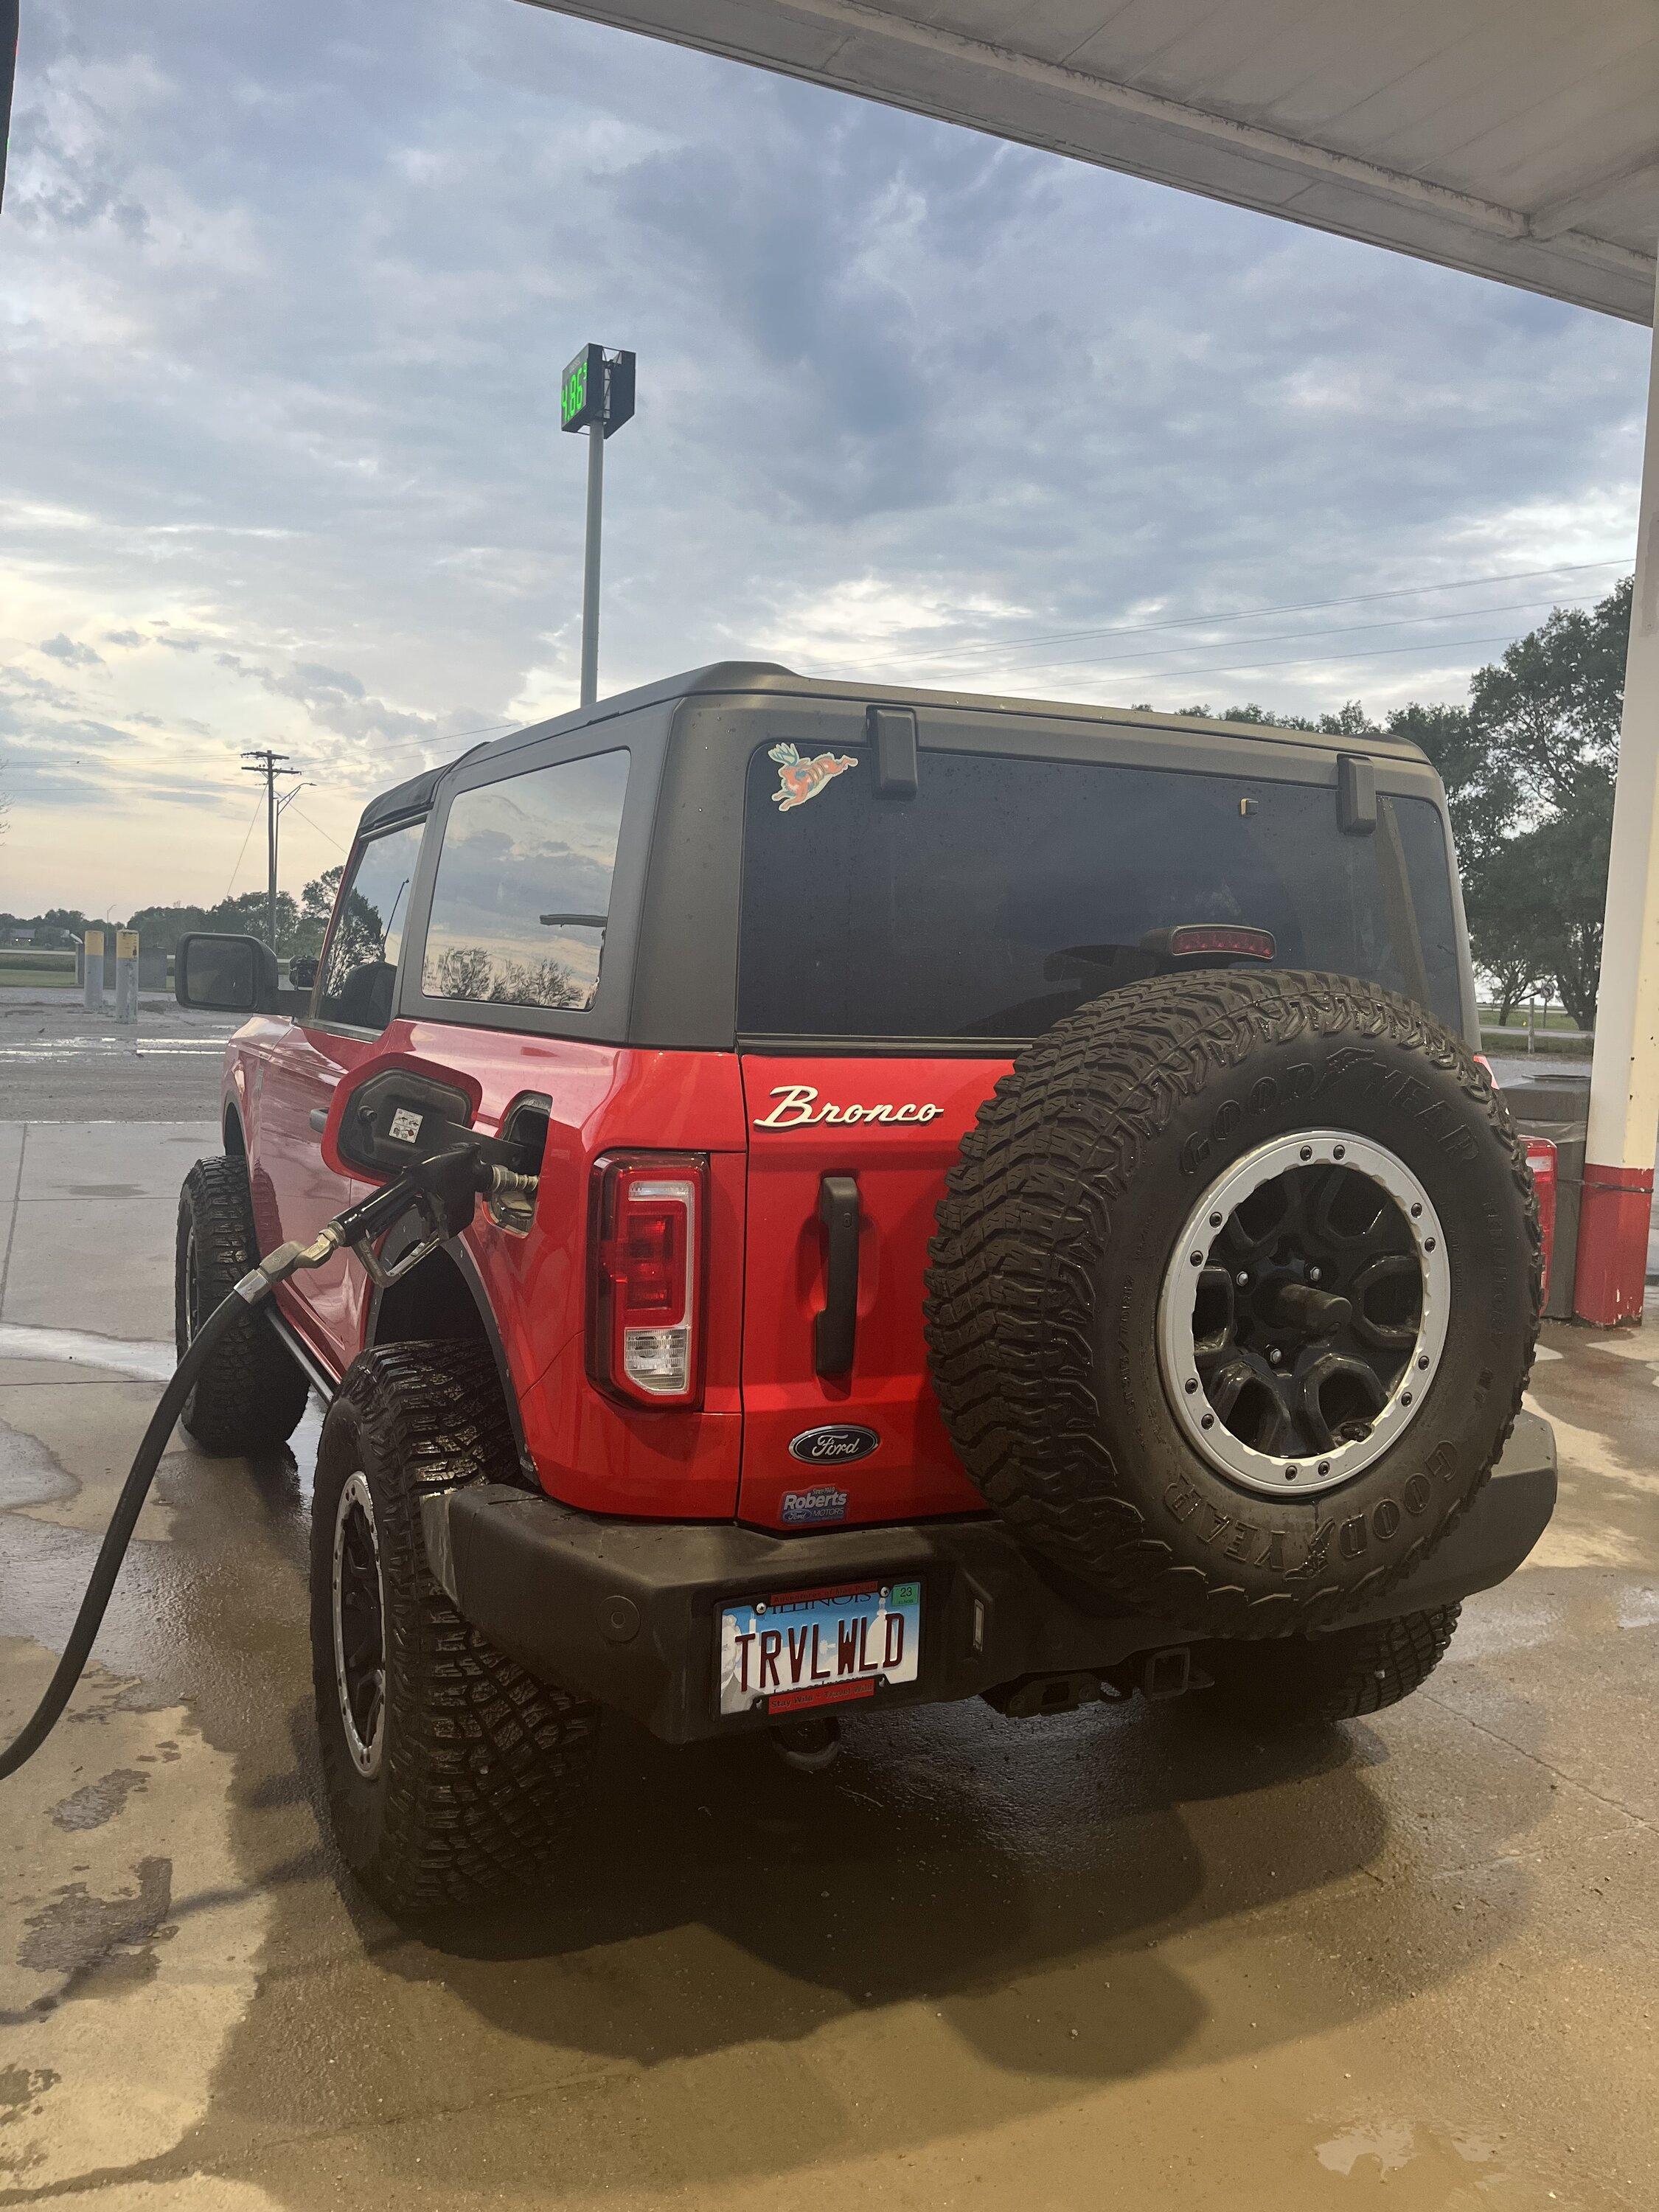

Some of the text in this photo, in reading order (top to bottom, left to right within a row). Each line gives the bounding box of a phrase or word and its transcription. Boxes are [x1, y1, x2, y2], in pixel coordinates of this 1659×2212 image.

[754, 1085, 945, 1127] Bronco
[812, 1434, 860, 1457] Ford
[784, 1491, 847, 1510] Roberts
[788, 1511, 806, 1520] Ford
[813, 1507, 844, 1517] MOTORS
[900, 1587, 912, 1597] 23
[771, 1699, 791, 1708] Stay
[793, 1694, 813, 1703] Wild
